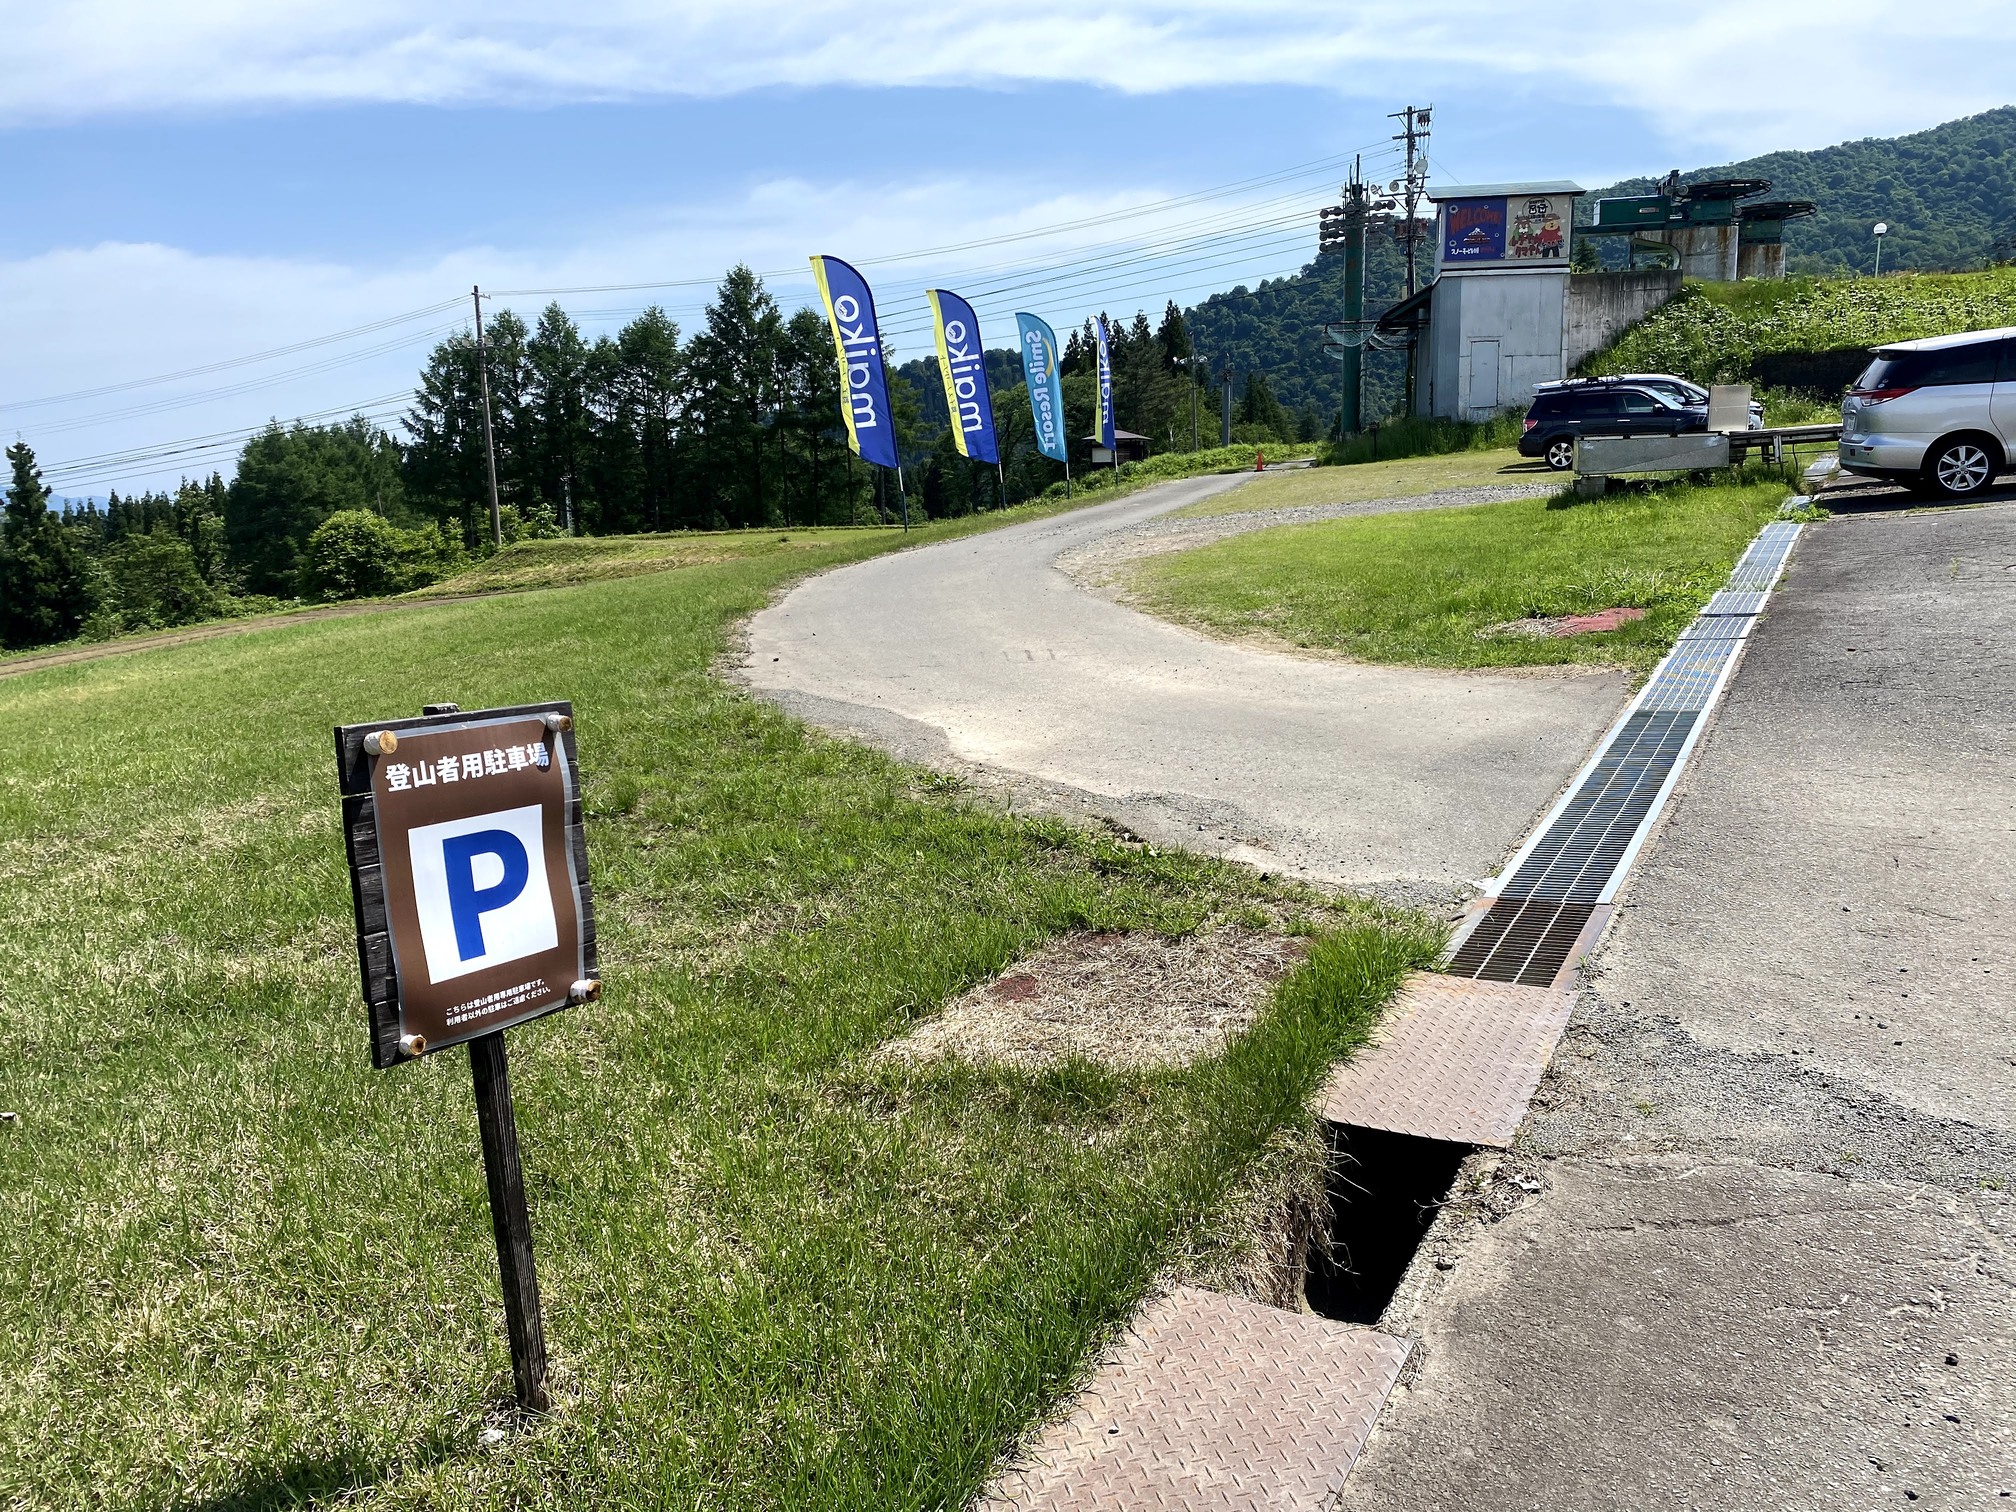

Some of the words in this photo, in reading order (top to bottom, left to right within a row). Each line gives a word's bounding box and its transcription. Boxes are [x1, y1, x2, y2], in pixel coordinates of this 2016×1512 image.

[385, 742, 550, 792] 登山者用駐車場
[442, 829, 529, 962] P
